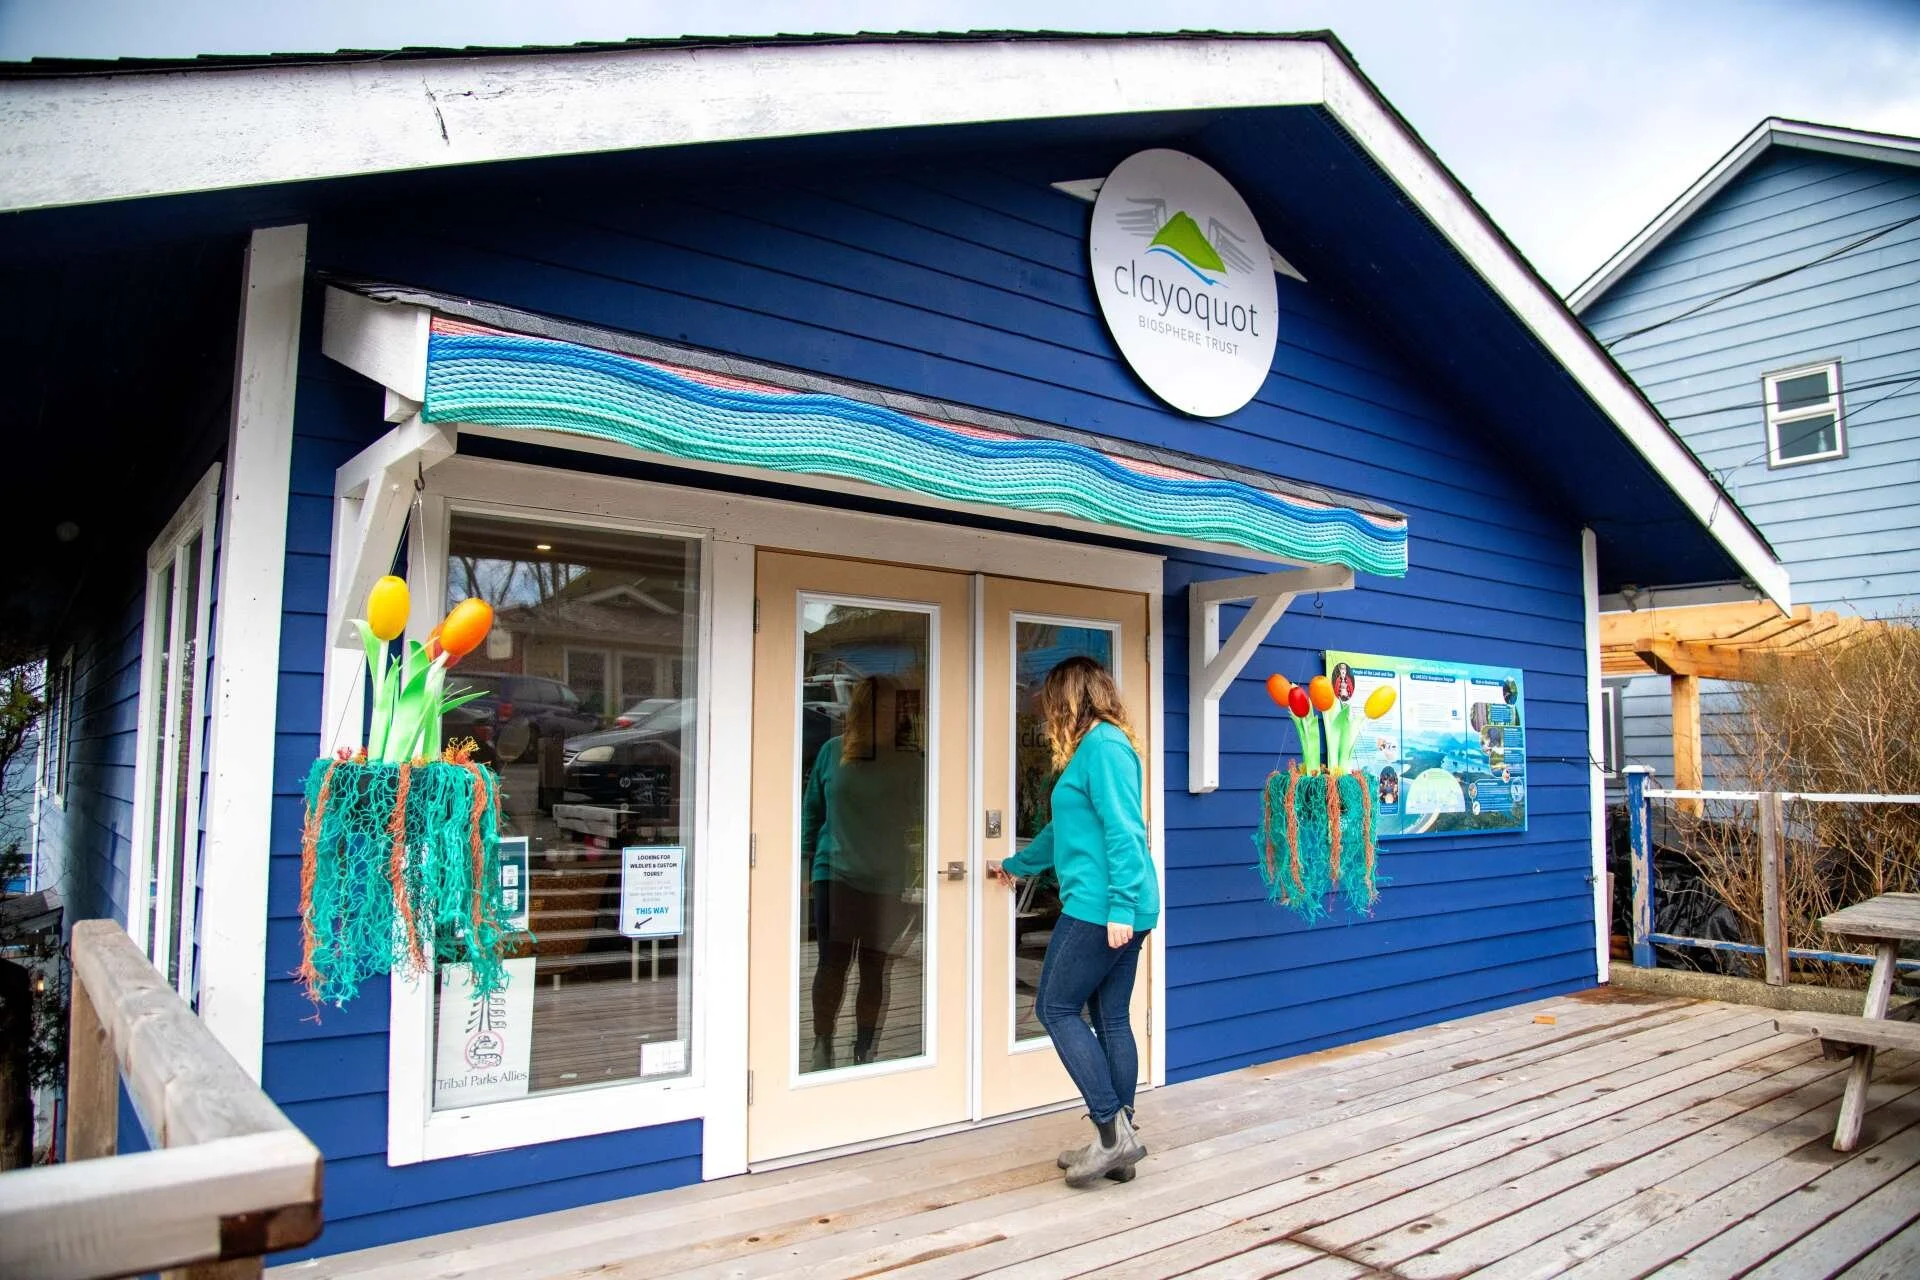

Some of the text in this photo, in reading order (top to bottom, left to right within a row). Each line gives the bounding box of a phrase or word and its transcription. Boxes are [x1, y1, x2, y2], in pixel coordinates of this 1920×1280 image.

[1114, 259, 1259, 337] clayoquot
[1138, 314, 1240, 357] BIOSPHERE TRUST
[636, 906, 669, 915] THIS WAY
[437, 1070, 528, 1090] Tribal Parks Allies
